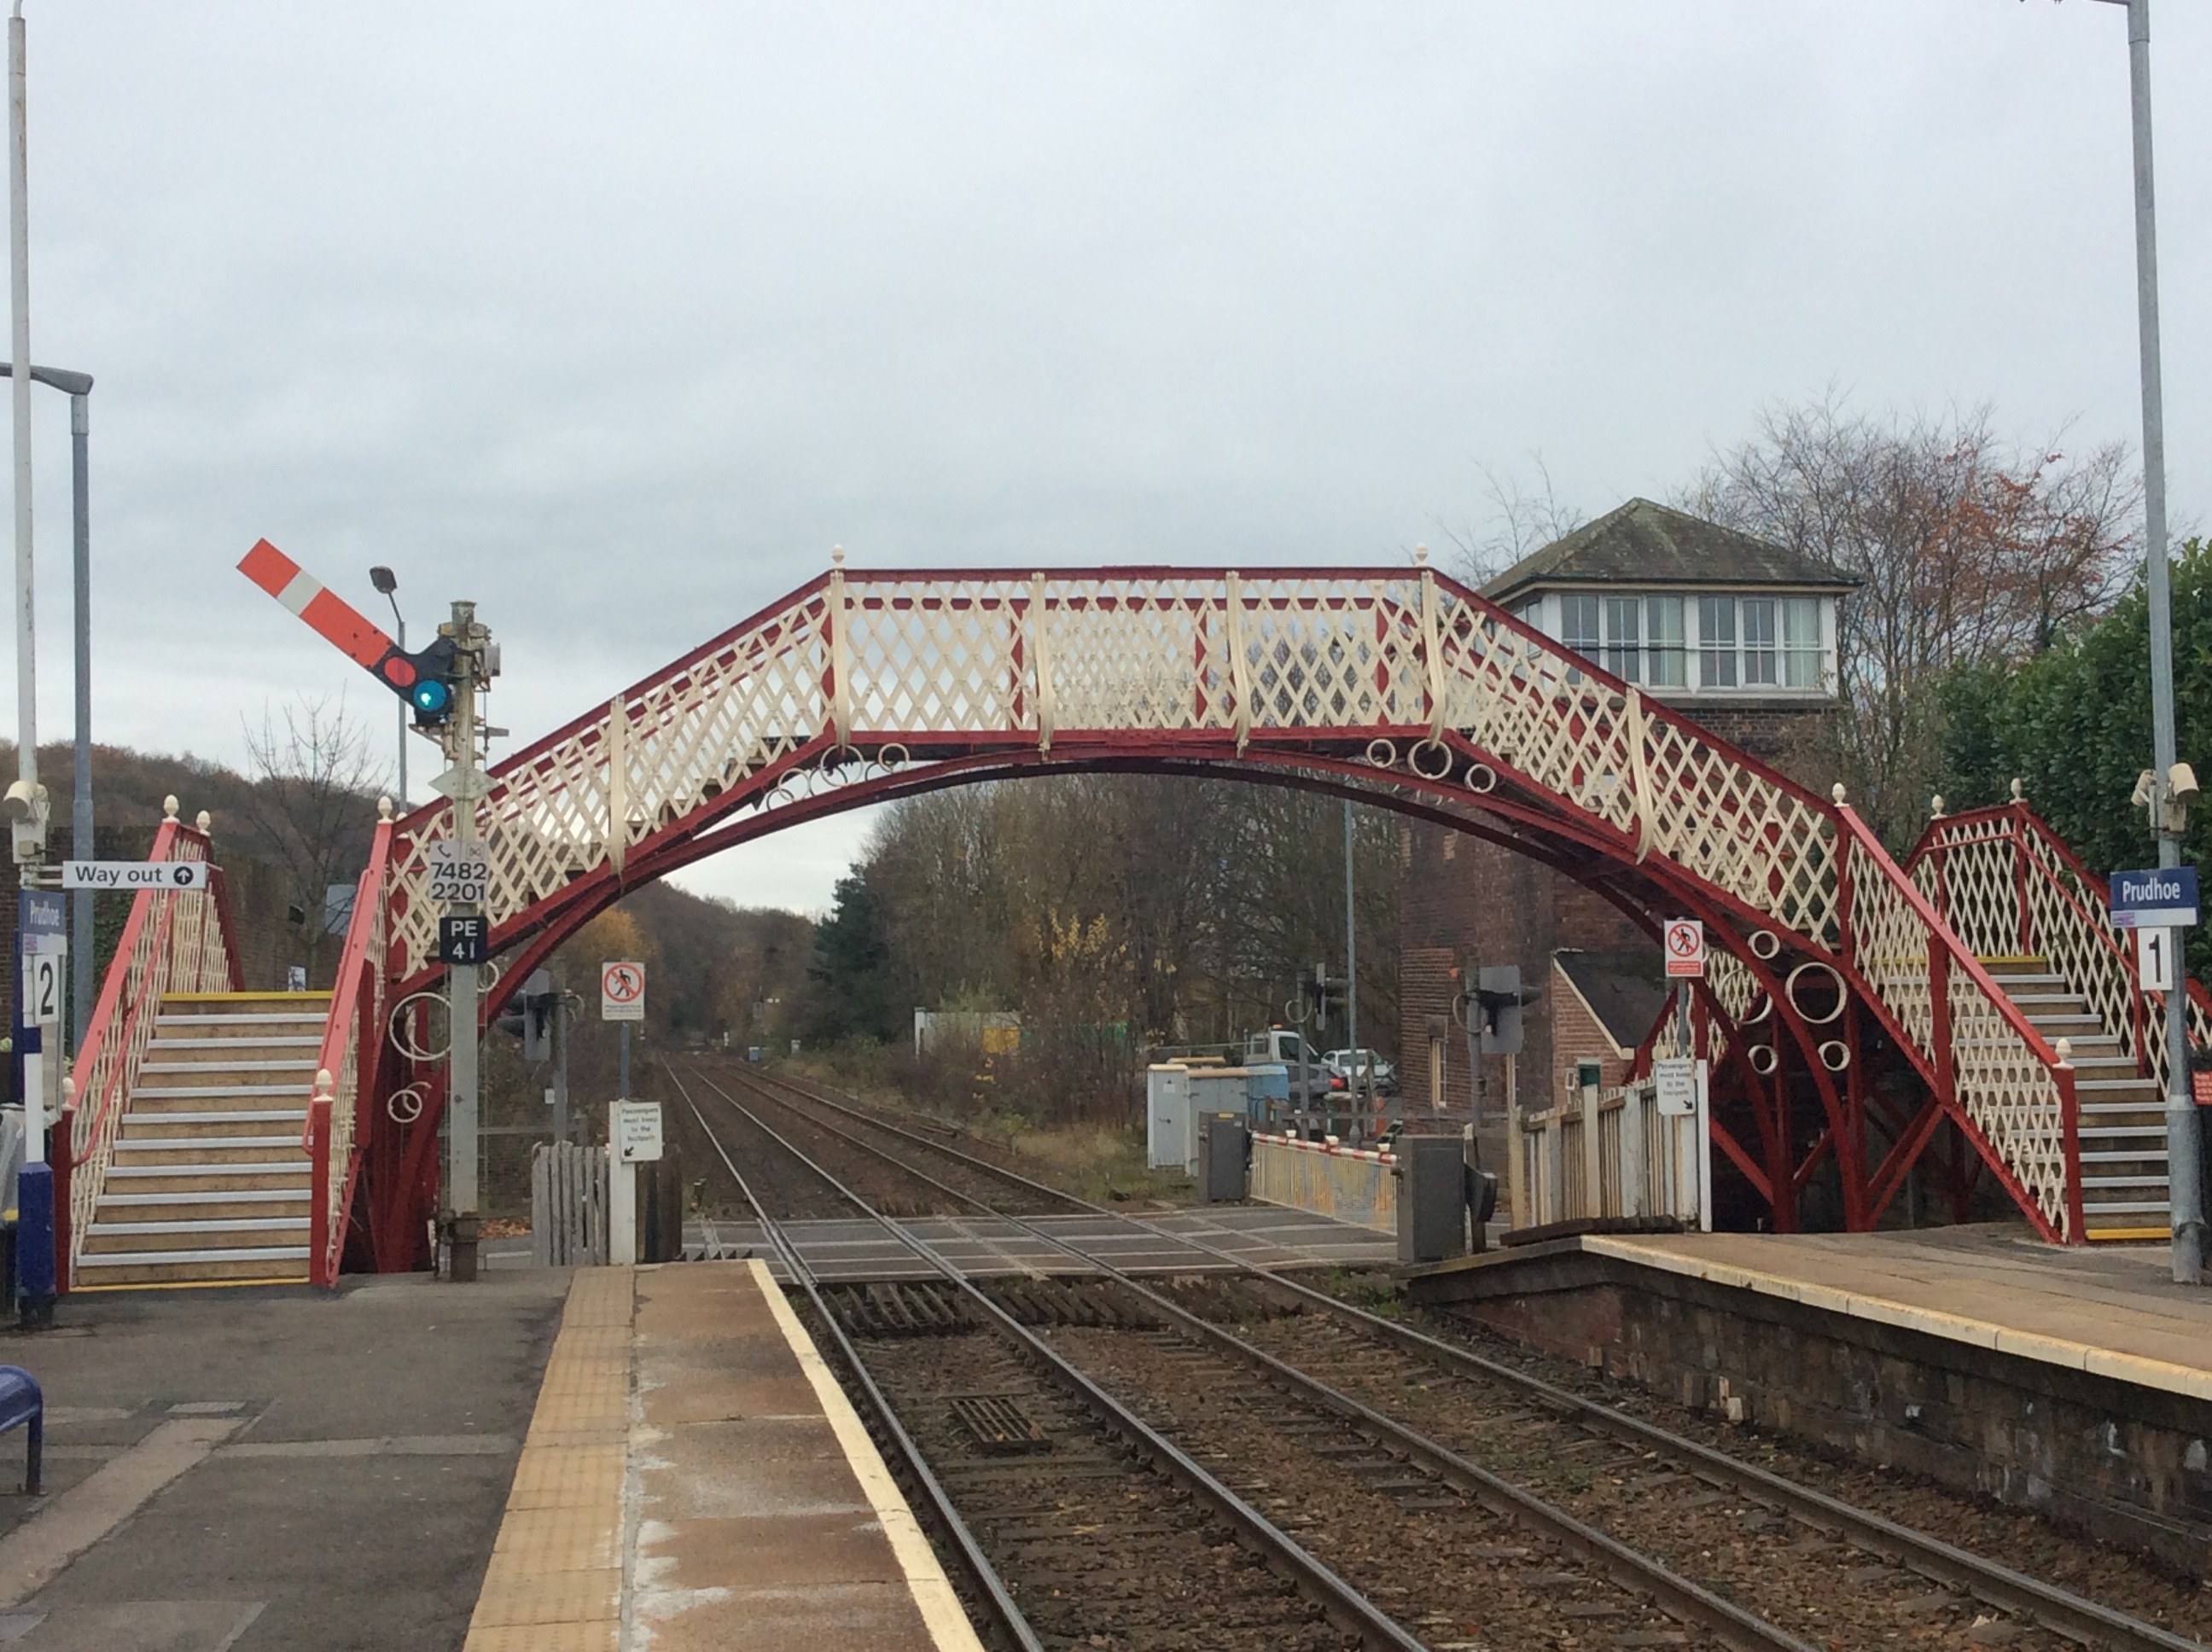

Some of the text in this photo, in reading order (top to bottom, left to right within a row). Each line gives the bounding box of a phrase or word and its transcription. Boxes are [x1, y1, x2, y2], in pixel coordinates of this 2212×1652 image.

[75, 865, 162, 887] Way out
[431, 862, 487, 880] 7482
[431, 881, 485, 901] 2201
[2122, 877, 2181, 902] Prudhoe
[30, 899, 60, 927] Prudhoe
[451, 920, 479, 937] PE
[2148, 934, 2162, 983] 1
[39, 961, 54, 1016] 2
